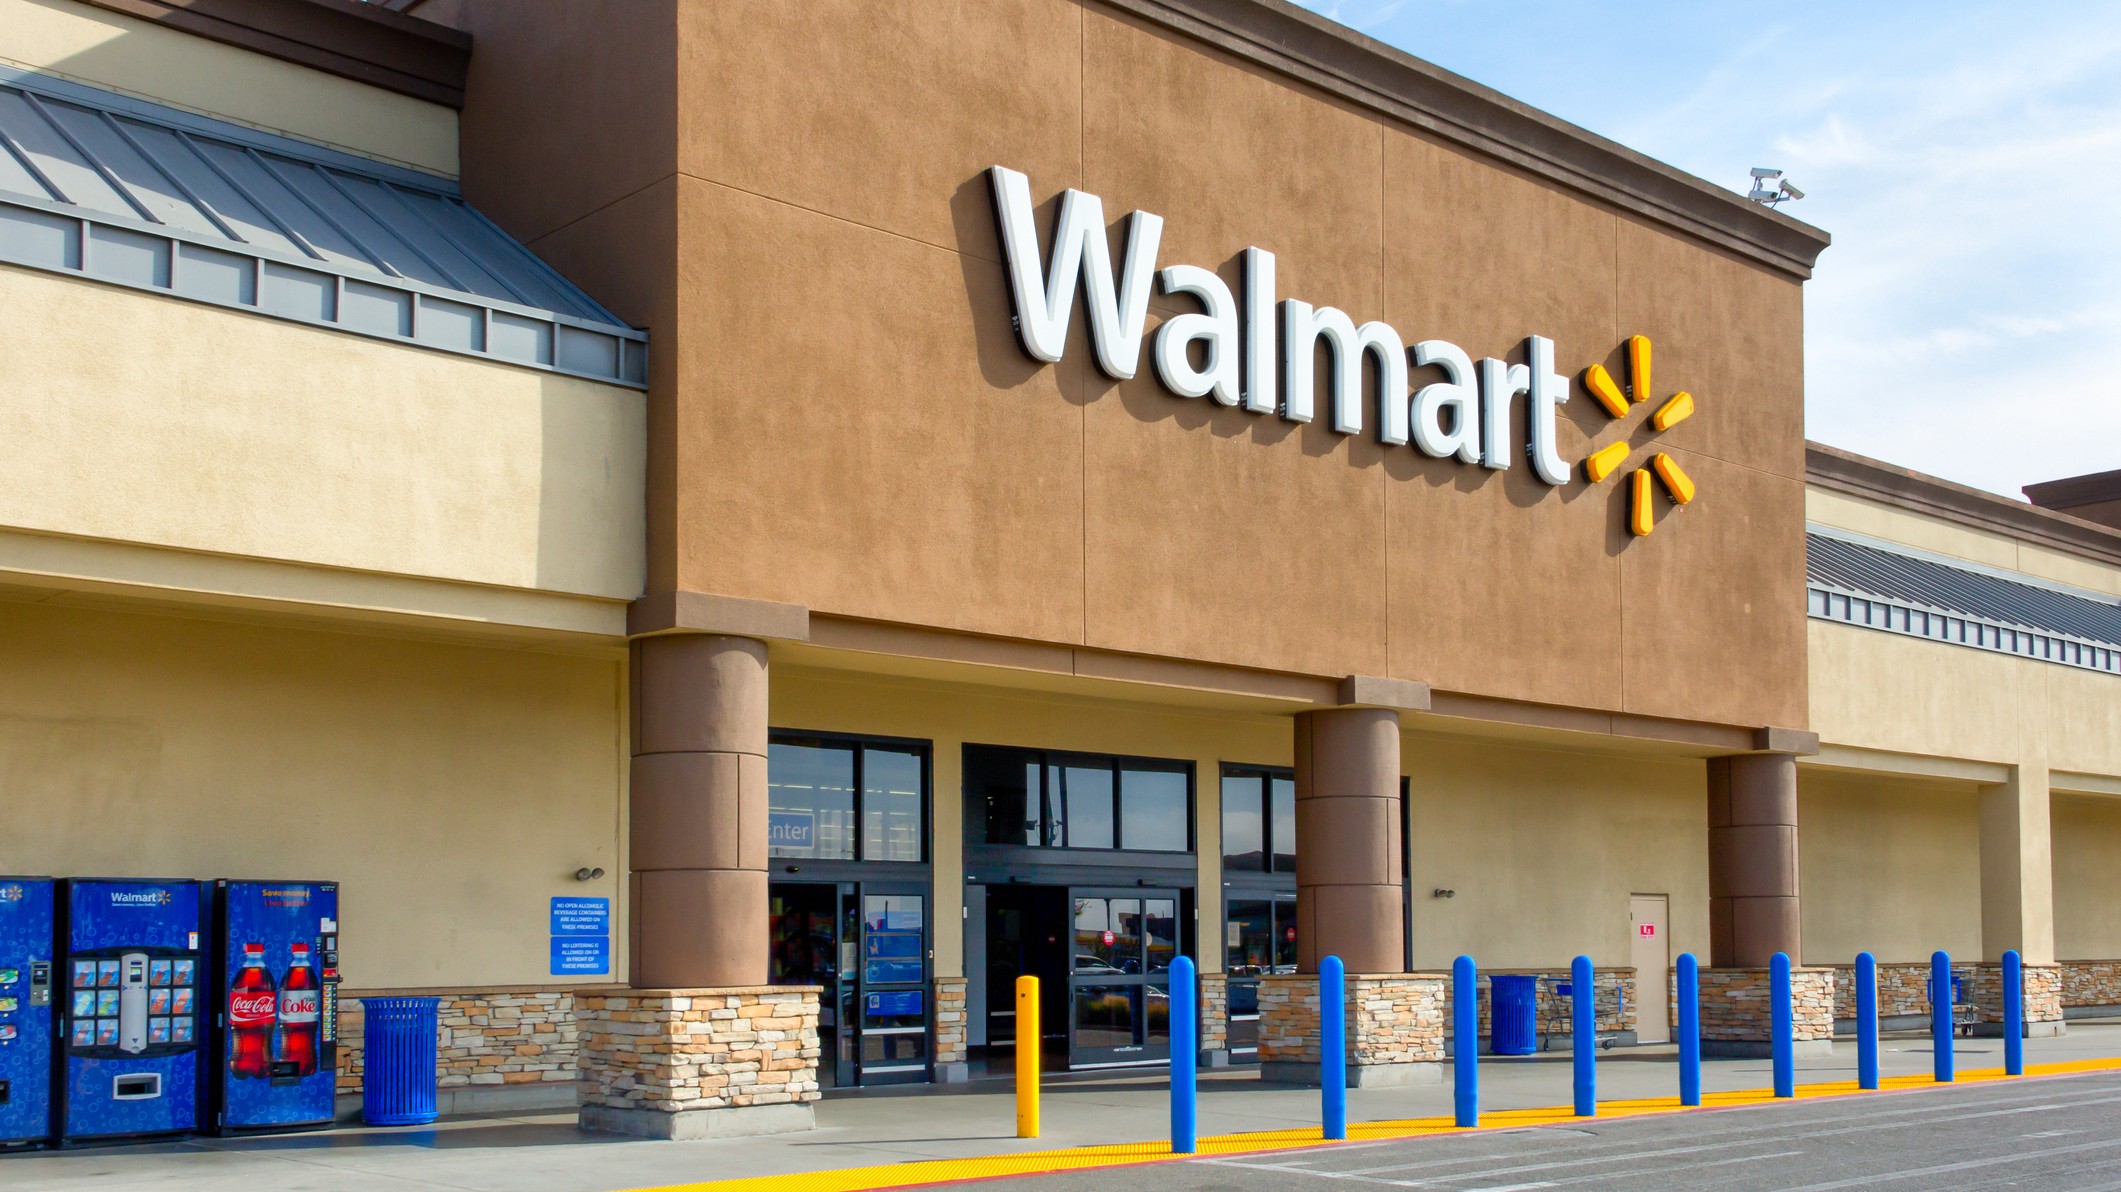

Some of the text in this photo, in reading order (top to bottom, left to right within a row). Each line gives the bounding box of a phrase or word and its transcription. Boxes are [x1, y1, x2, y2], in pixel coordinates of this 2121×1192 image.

[989, 164, 1570, 486] Walmart
[768, 819, 809, 840] nter
[111, 892, 157, 902] Walmart
[262, 889, 282, 897] Save
[232, 996, 275, 1014] Coca-Cola
[282, 998, 316, 1015] Coke
